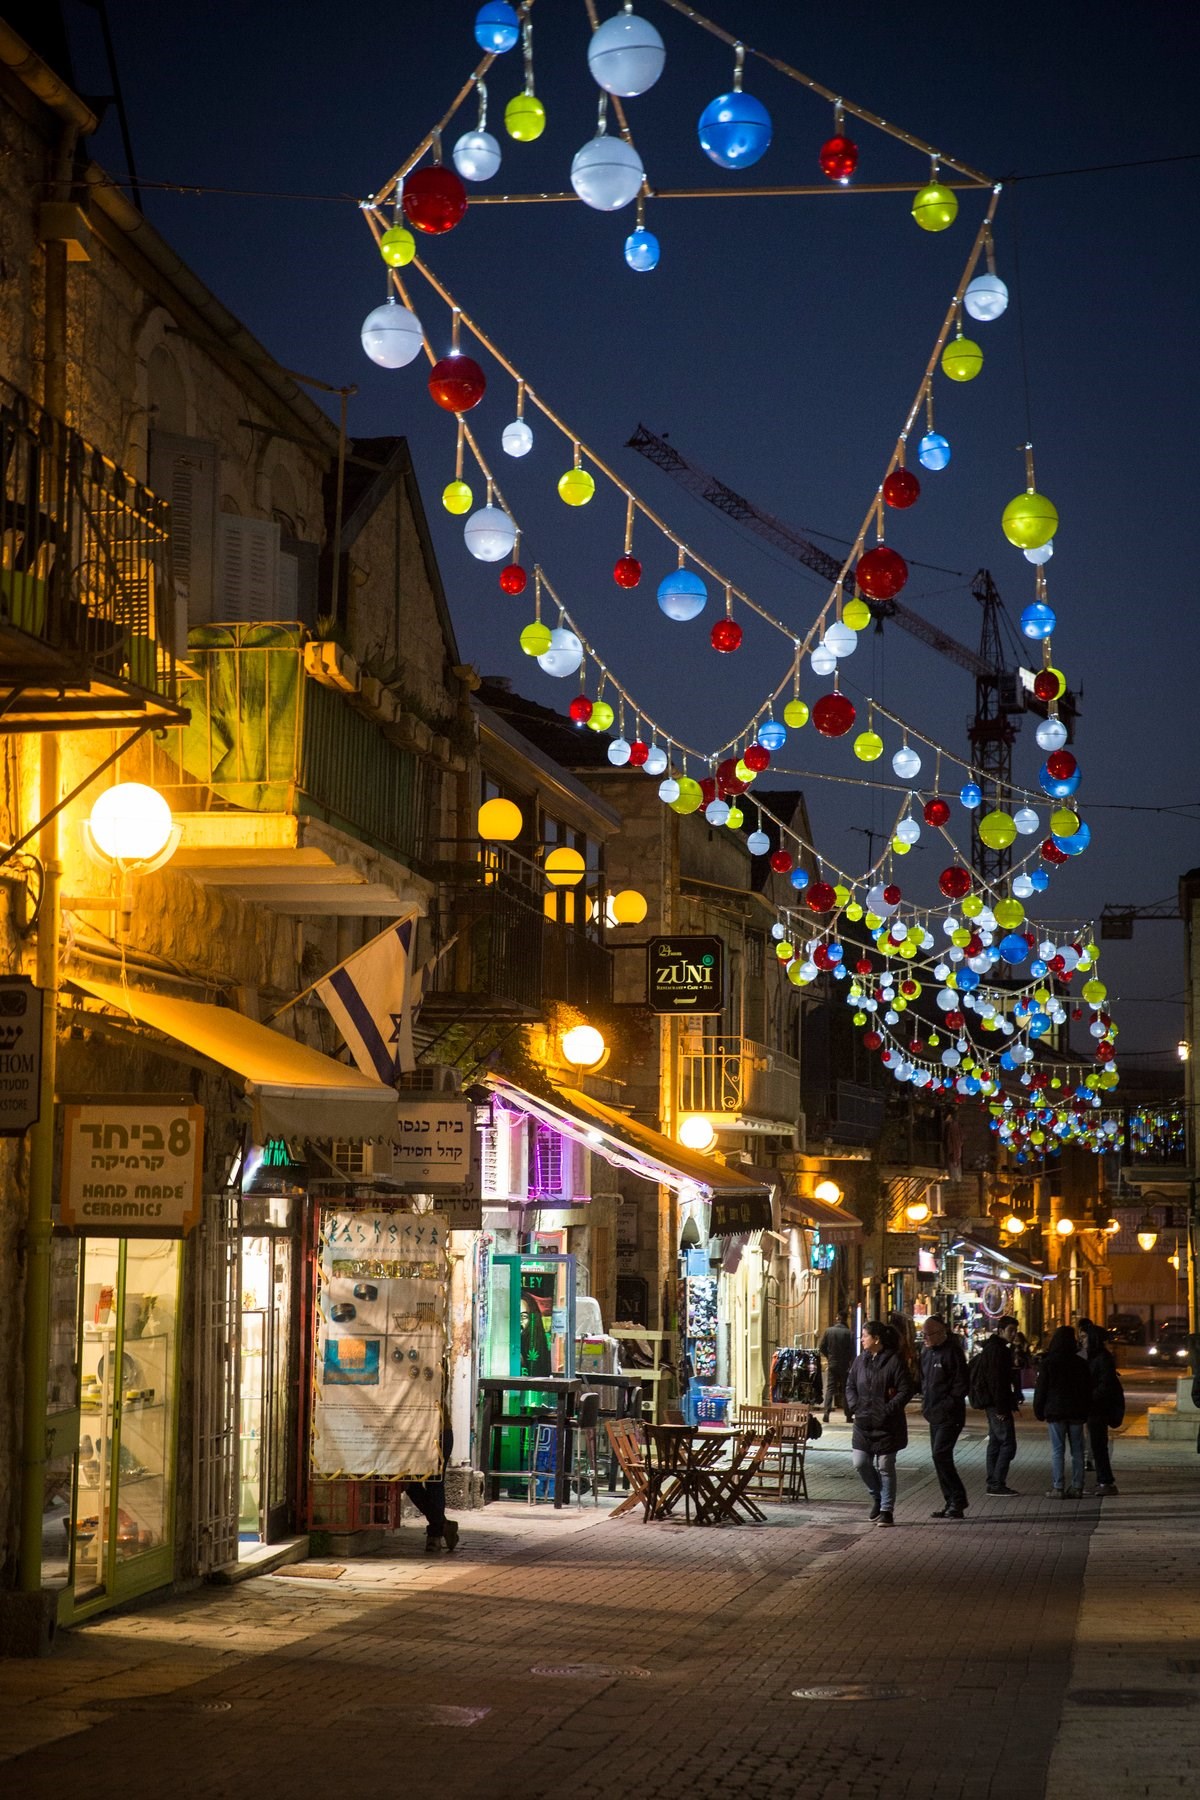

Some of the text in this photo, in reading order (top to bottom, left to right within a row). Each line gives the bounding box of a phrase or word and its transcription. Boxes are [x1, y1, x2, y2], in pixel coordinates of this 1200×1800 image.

[658, 944, 672, 957] 24
[436, 1120, 464, 1133] בית
[80, 1124, 165, 1150] ביחד
[436, 1141, 463, 1161] קהל
[91, 1155, 165, 1171] קרמיקה
[82, 1184, 183, 1199] HAND MADE
[82, 1202, 162, 1217] CERAMICS
